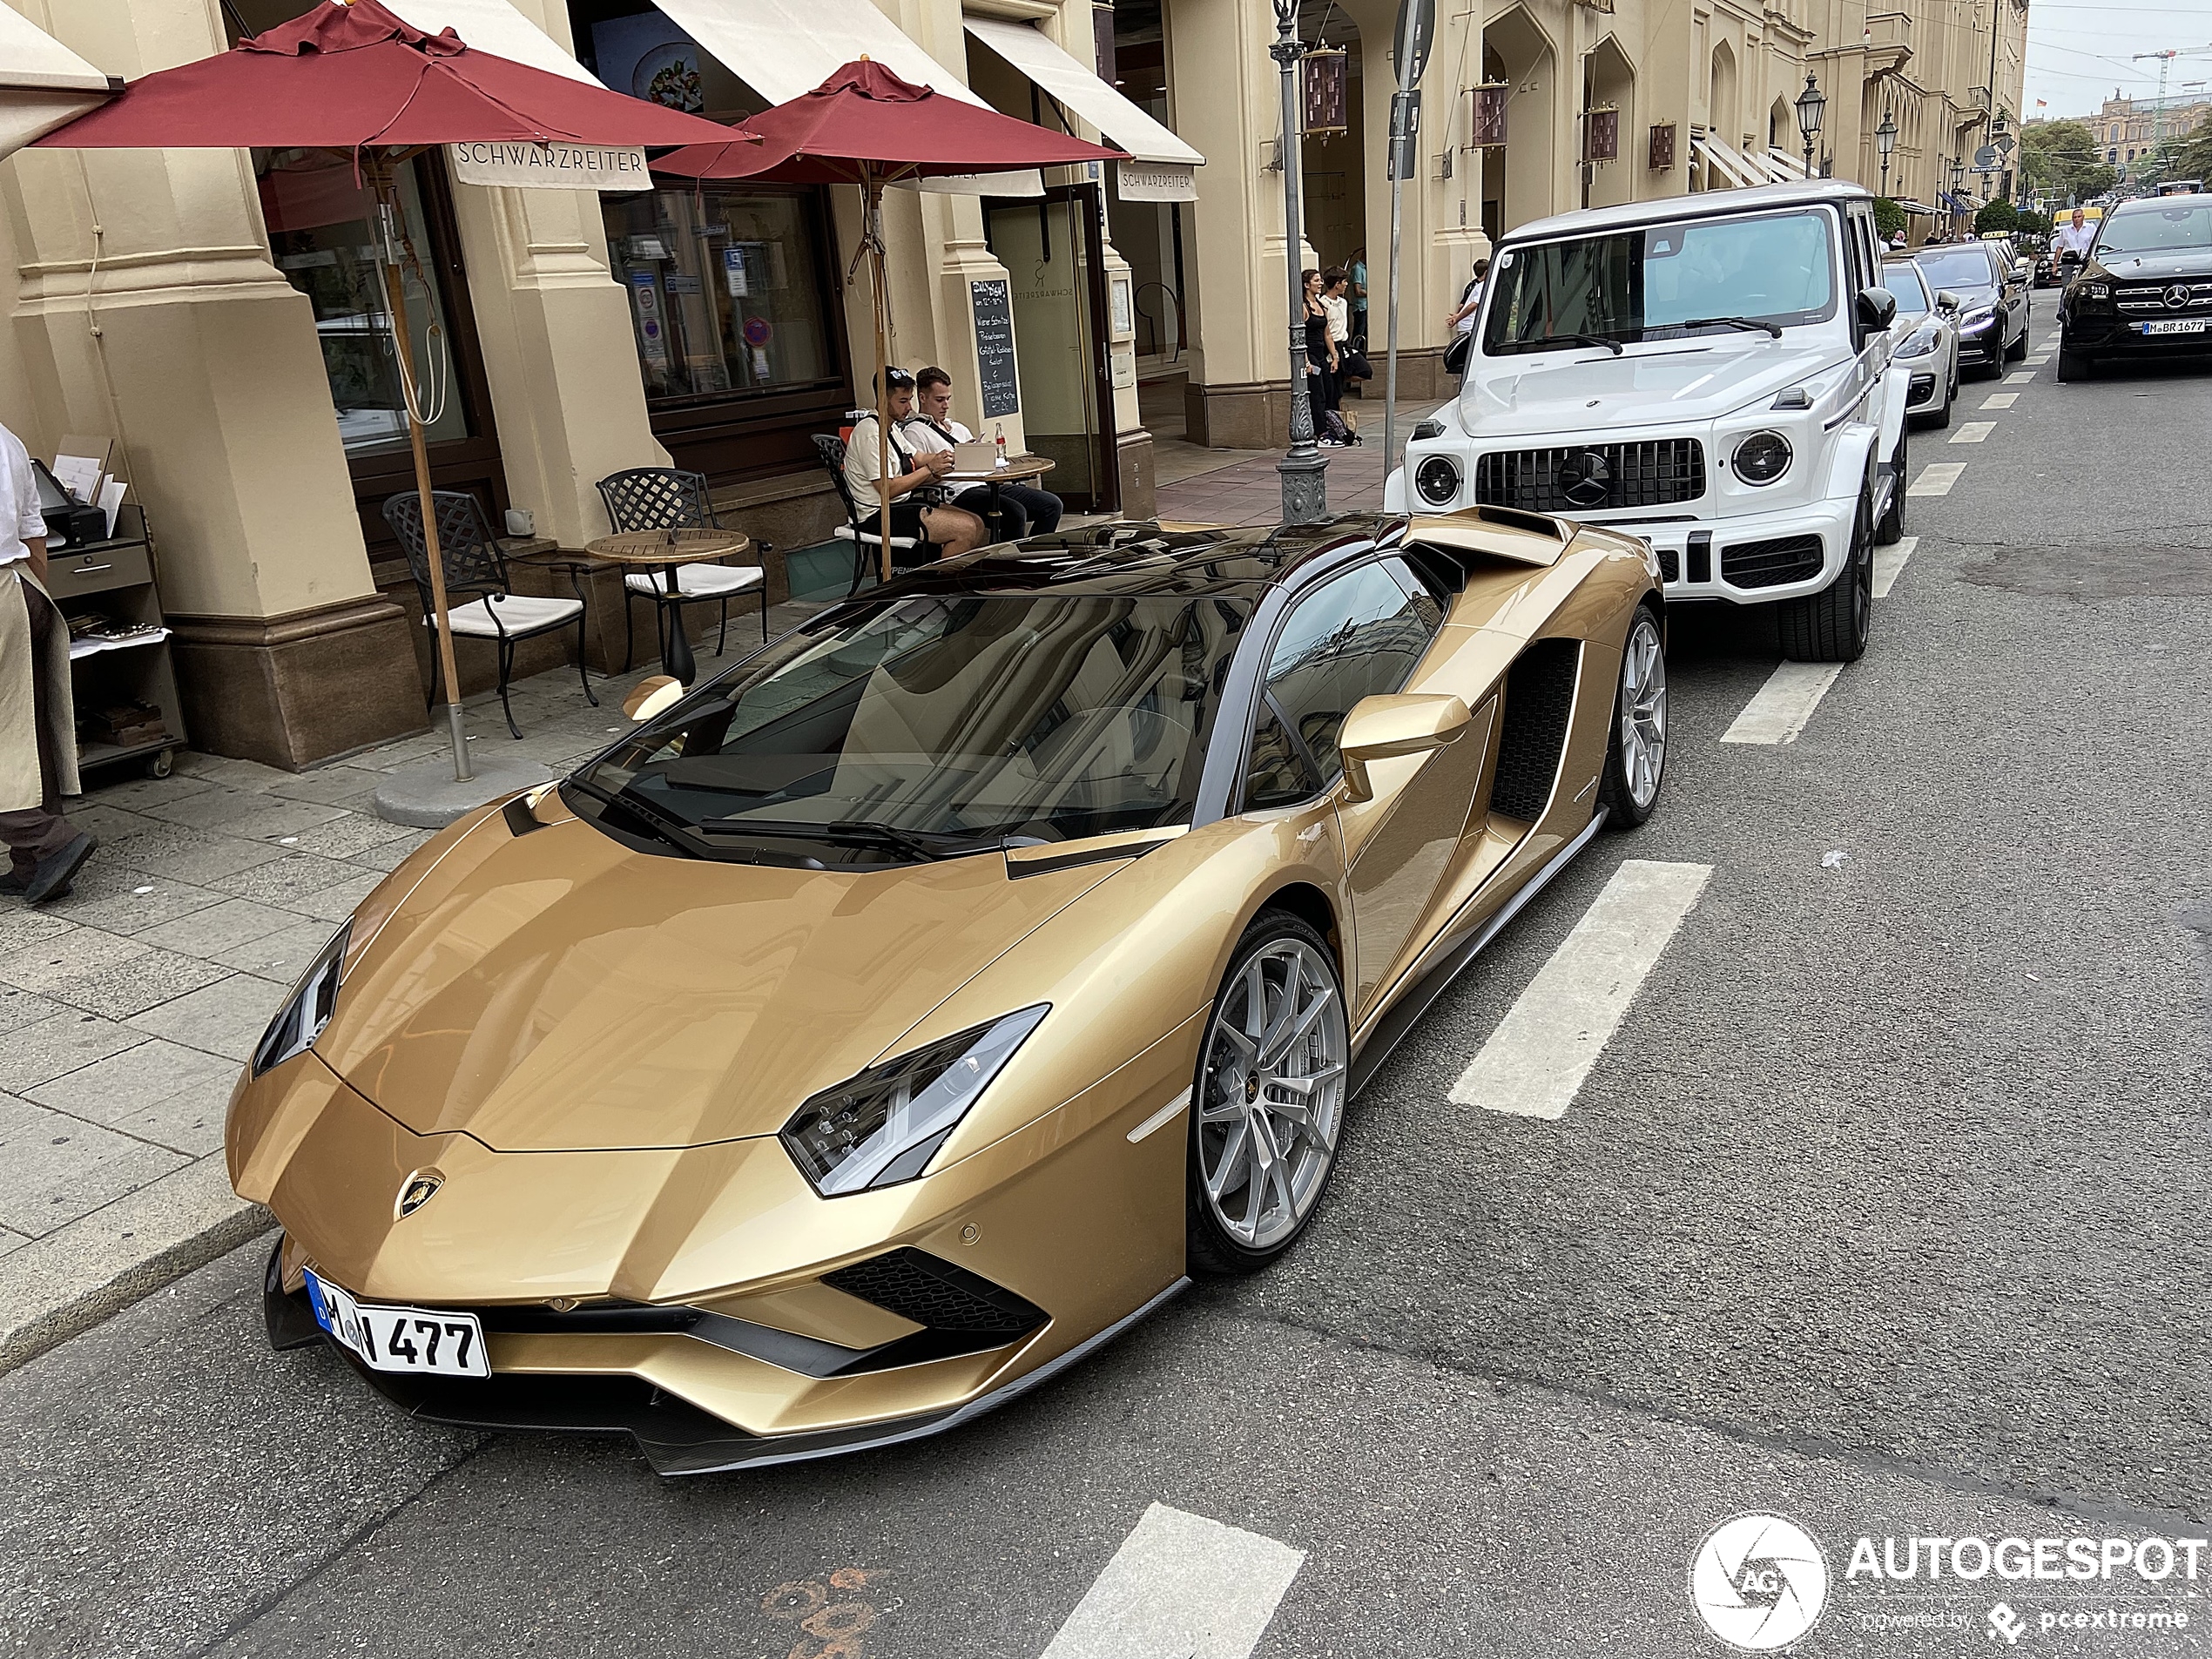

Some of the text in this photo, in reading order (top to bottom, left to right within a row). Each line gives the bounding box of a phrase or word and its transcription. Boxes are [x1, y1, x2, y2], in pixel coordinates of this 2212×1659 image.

[458, 143, 642, 172] SCHWARZREITER
[1123, 173, 1190, 188] SCHWARZREITER
[2163, 323, 2176, 332] BR
[2177, 321, 2203, 332] 1677
[388, 1318, 473, 1368] 477
